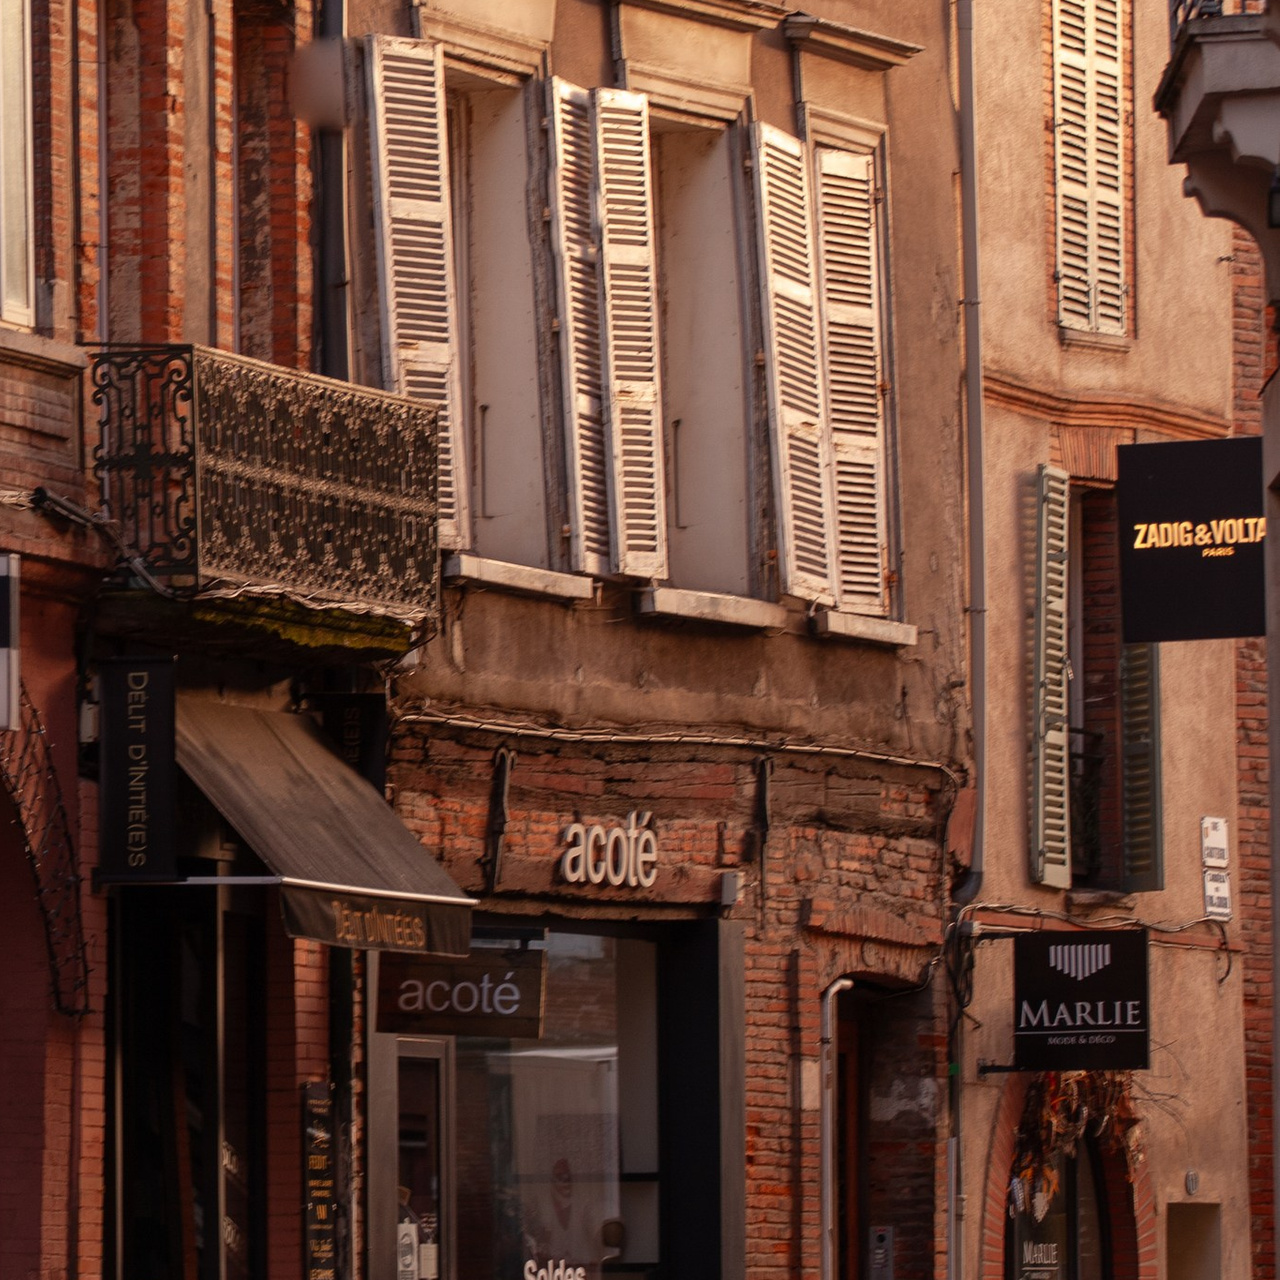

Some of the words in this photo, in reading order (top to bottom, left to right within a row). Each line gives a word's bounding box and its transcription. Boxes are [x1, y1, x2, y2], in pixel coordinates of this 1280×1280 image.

[1201, 546, 1236, 558] PARIS
[127, 671, 150, 734] DÉLIT
[563, 809, 659, 888] acoté
[397, 971, 522, 1015] acoté
[1019, 999, 1142, 1028] MARLIE
[1047, 1035, 1077, 1045] MODE
[1078, 1035, 1087, 1044] &
[1022, 1239, 1058, 1265] MARLIE
